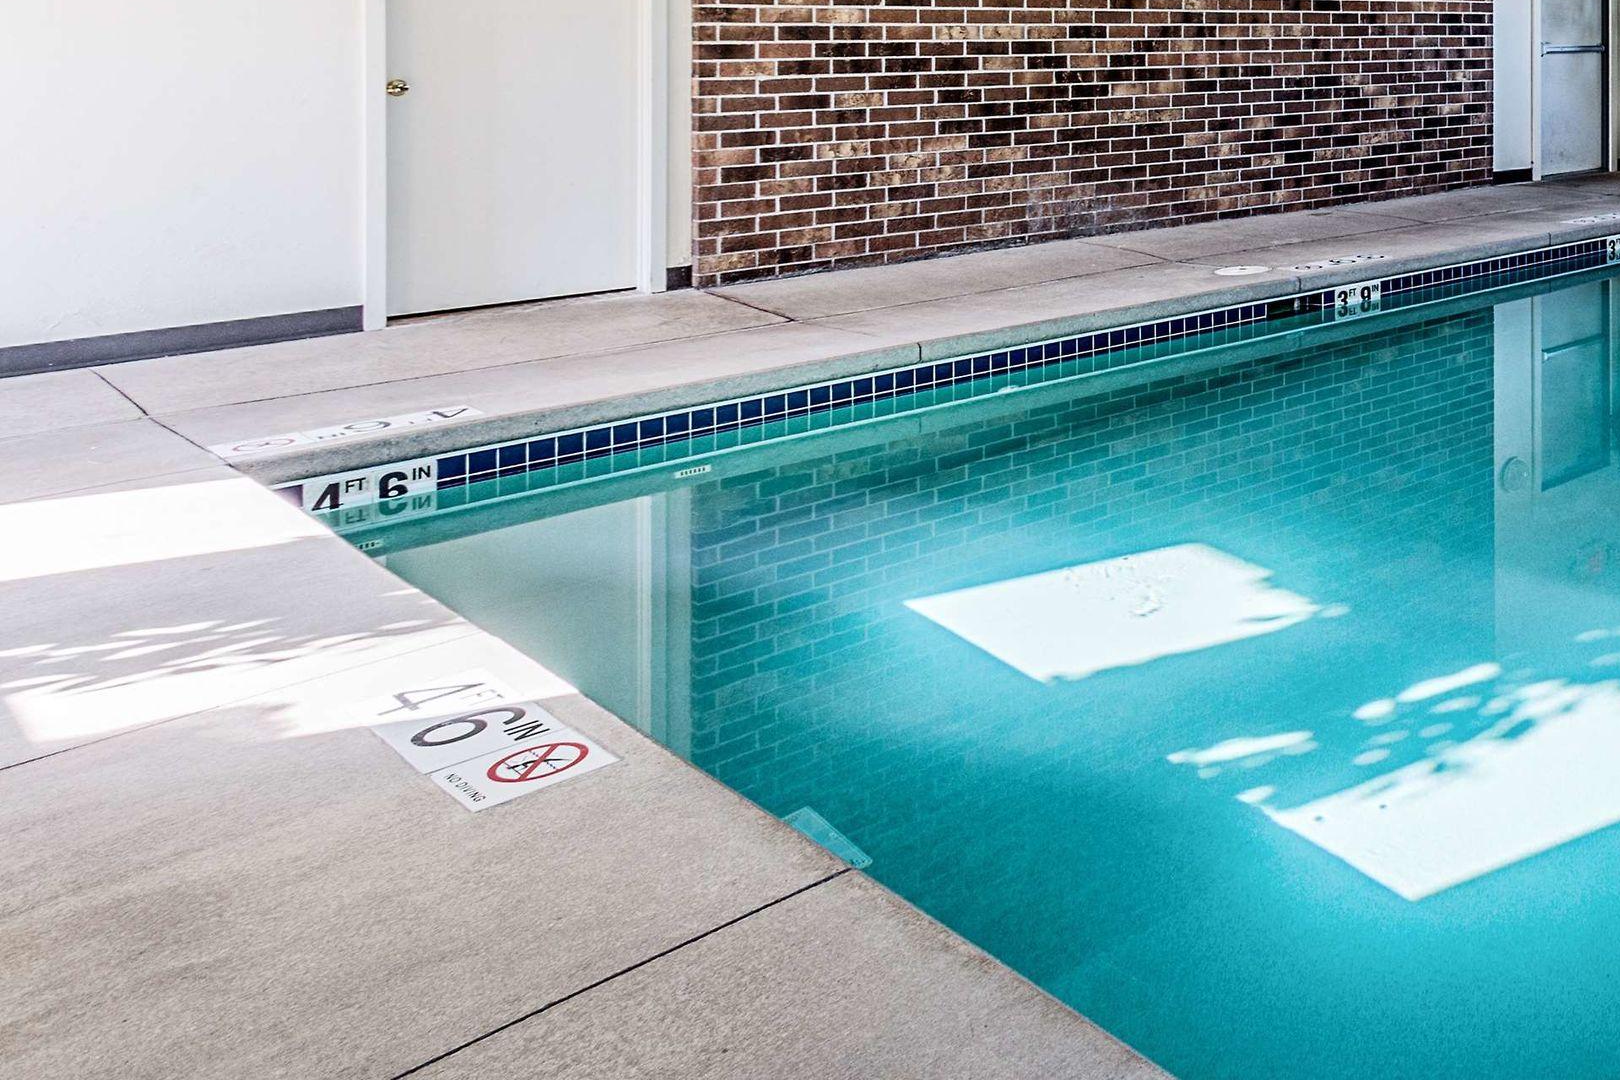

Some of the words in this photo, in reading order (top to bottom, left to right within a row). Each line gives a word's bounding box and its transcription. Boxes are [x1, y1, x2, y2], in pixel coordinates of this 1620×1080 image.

[1349, 288, 1356, 297] FT
[1372, 284, 1379, 292] IN
[312, 482, 344, 511] 4
[345, 477, 366, 493] FT
[379, 471, 408, 499] 6
[412, 465, 431, 481] IN
[410, 706, 526, 747] 6
[503, 720, 550, 741] IN
[444, 773, 461, 783] NO
[455, 782, 486, 802] DIVING
